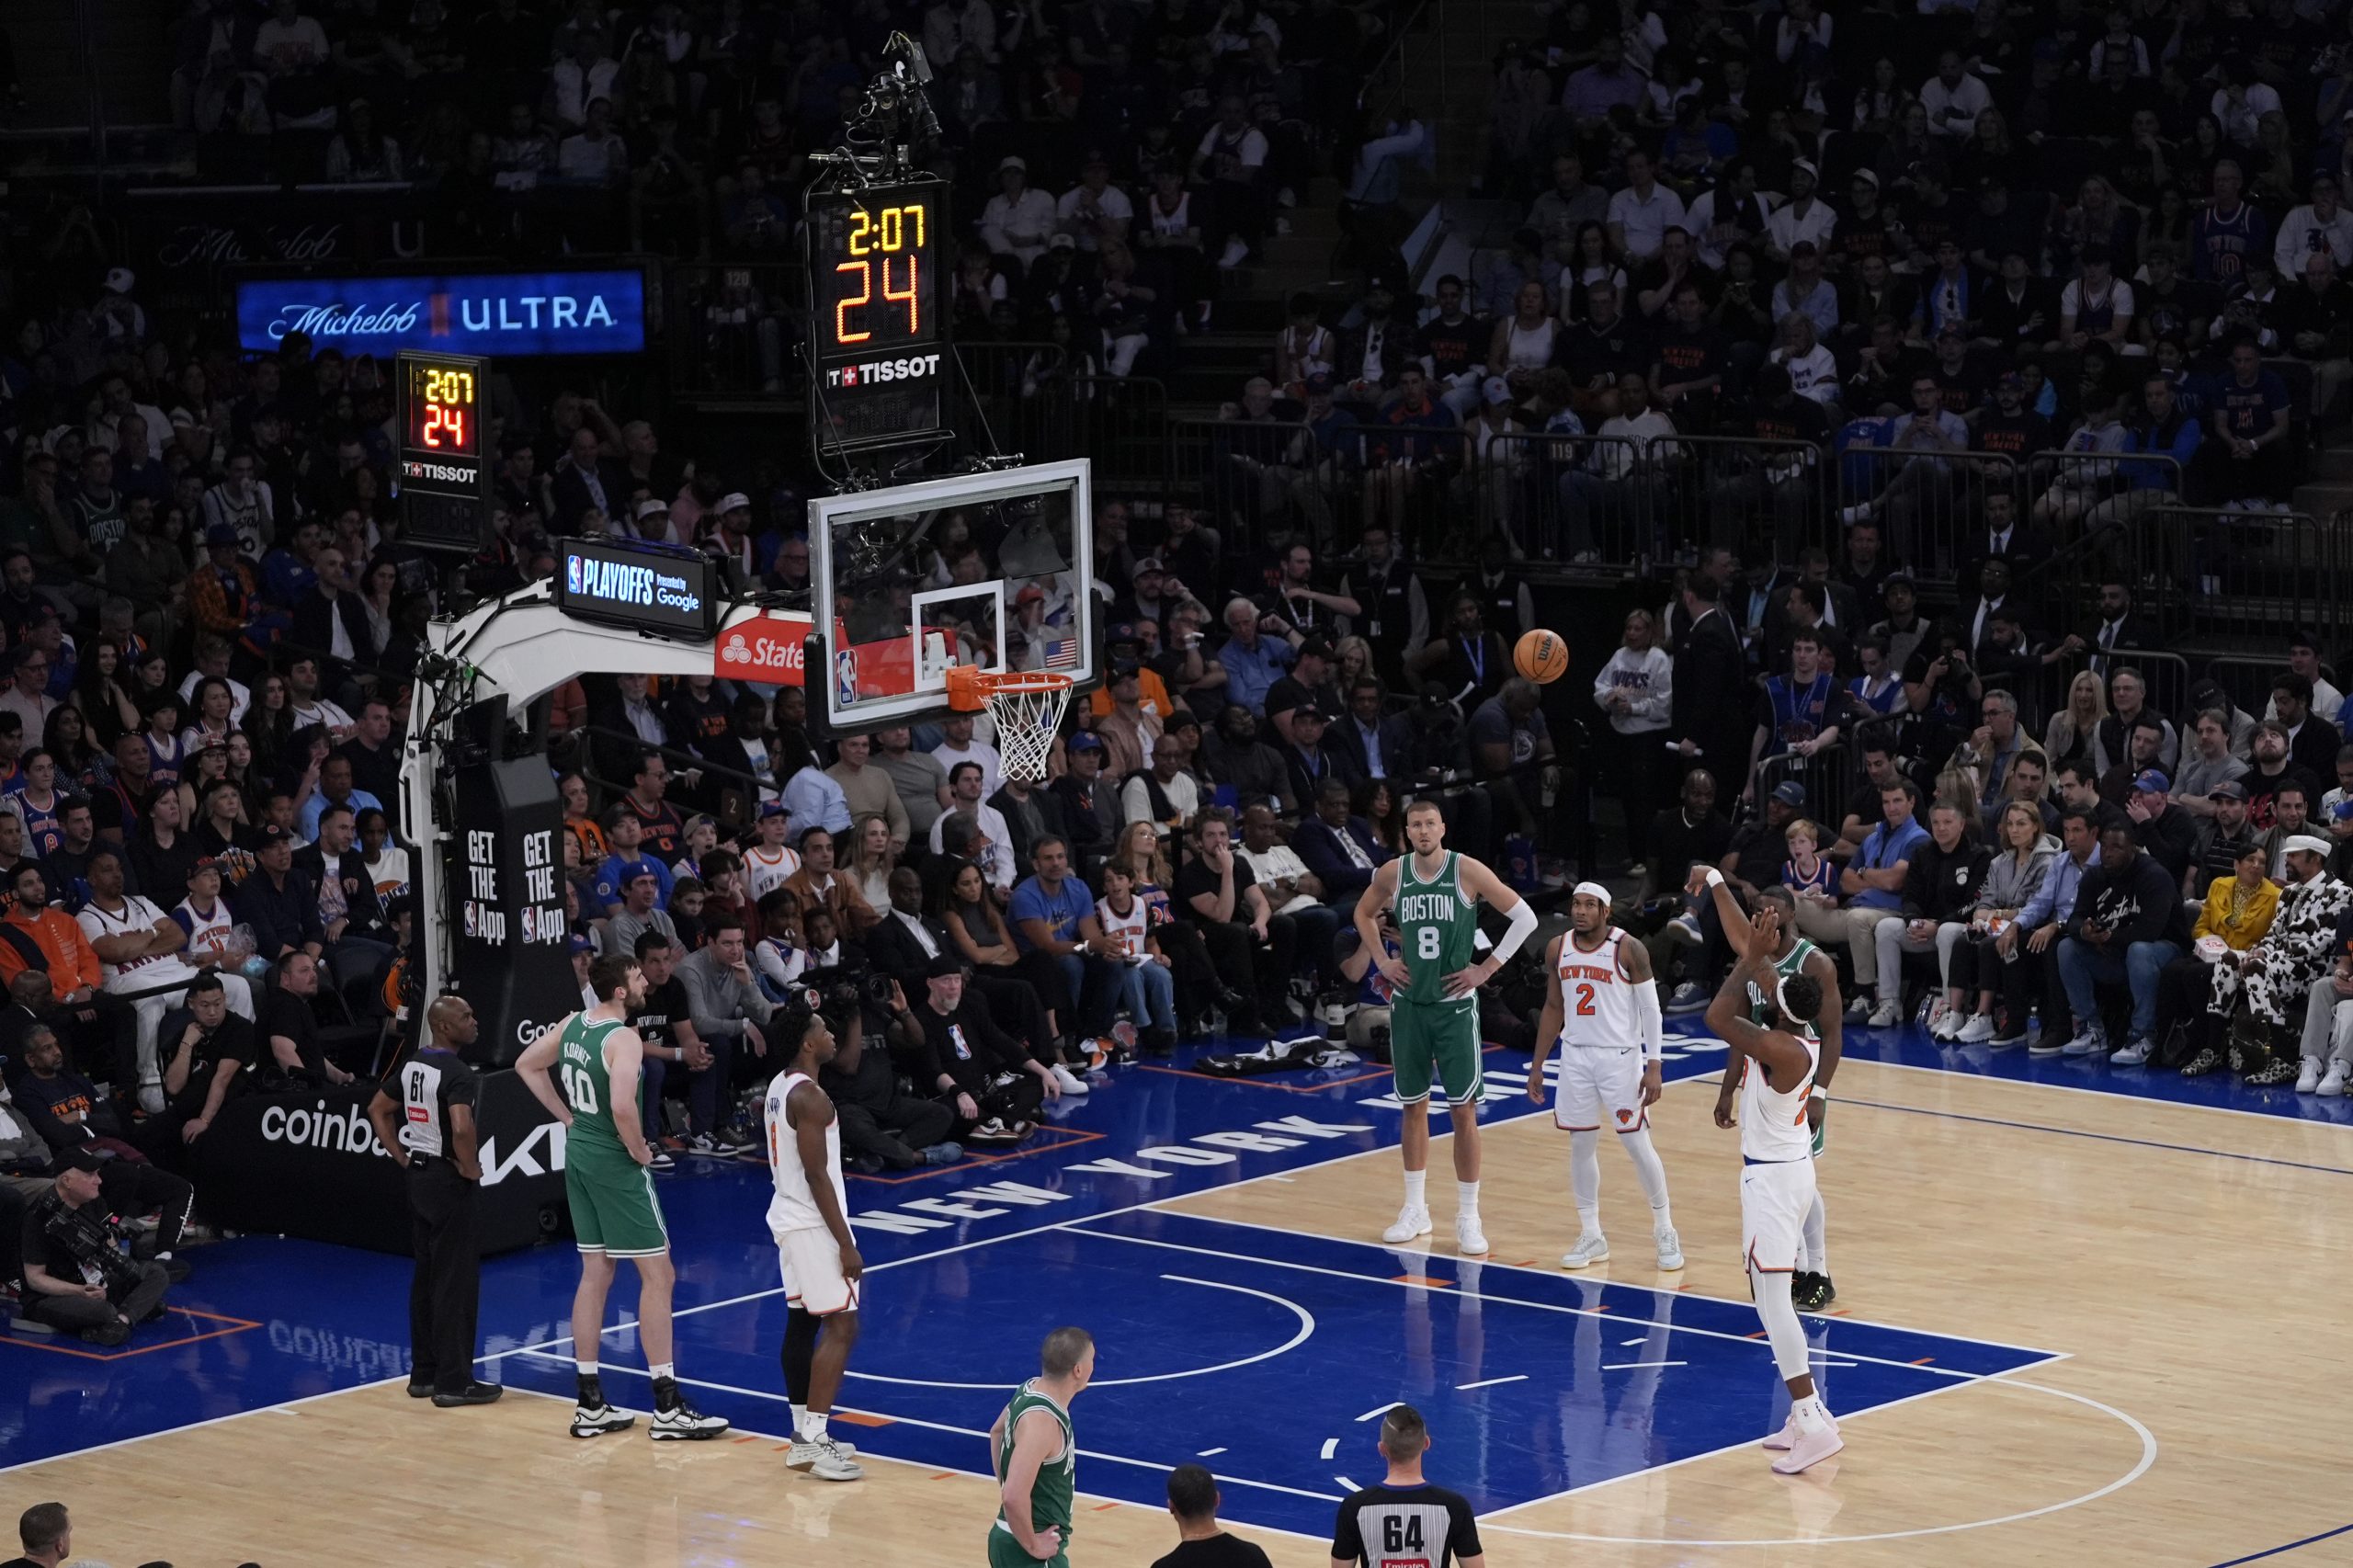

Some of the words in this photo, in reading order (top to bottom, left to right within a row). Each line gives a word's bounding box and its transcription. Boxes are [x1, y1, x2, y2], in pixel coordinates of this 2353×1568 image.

[849, 204, 924, 256] 2:07
[727, 271, 750, 287] 120
[267, 301, 422, 338] Michelob
[461, 295, 613, 332] ULTRA
[835, 254, 917, 344] 24
[426, 369, 473, 404] 2:07
[858, 354, 940, 384] TISSOT
[424, 404, 462, 447] 24
[1552, 443, 1573, 459] 119
[423, 464, 477, 483] TISSOT
[583, 558, 654, 606] PLAYOFFS
[656, 574, 679, 588] Presented
[679, 578, 687, 591] by
[657, 587, 699, 611] Google
[753, 637, 803, 670] State
[730, 798, 737, 813] 2
[468, 829, 494, 865] GET
[524, 830, 551, 867] GET
[469, 865, 497, 901] THE
[526, 866, 556, 903] THE
[478, 903, 506, 947] App
[536, 905, 565, 946] App
[1401, 893, 1455, 924] BOSTON
[1417, 926, 1441, 960] 8
[1560, 966, 1580, 981] NEW
[1580, 966, 1614, 984] YORK
[1575, 983, 1597, 1016] 2
[563, 1041, 592, 1068] KORNET
[410, 1071, 426, 1103] 61
[561, 1063, 599, 1115] 40
[850, 1180, 1073, 1234] NEW
[1063, 1115, 1377, 1178] YORK
[1383, 1515, 1424, 1552] 64
